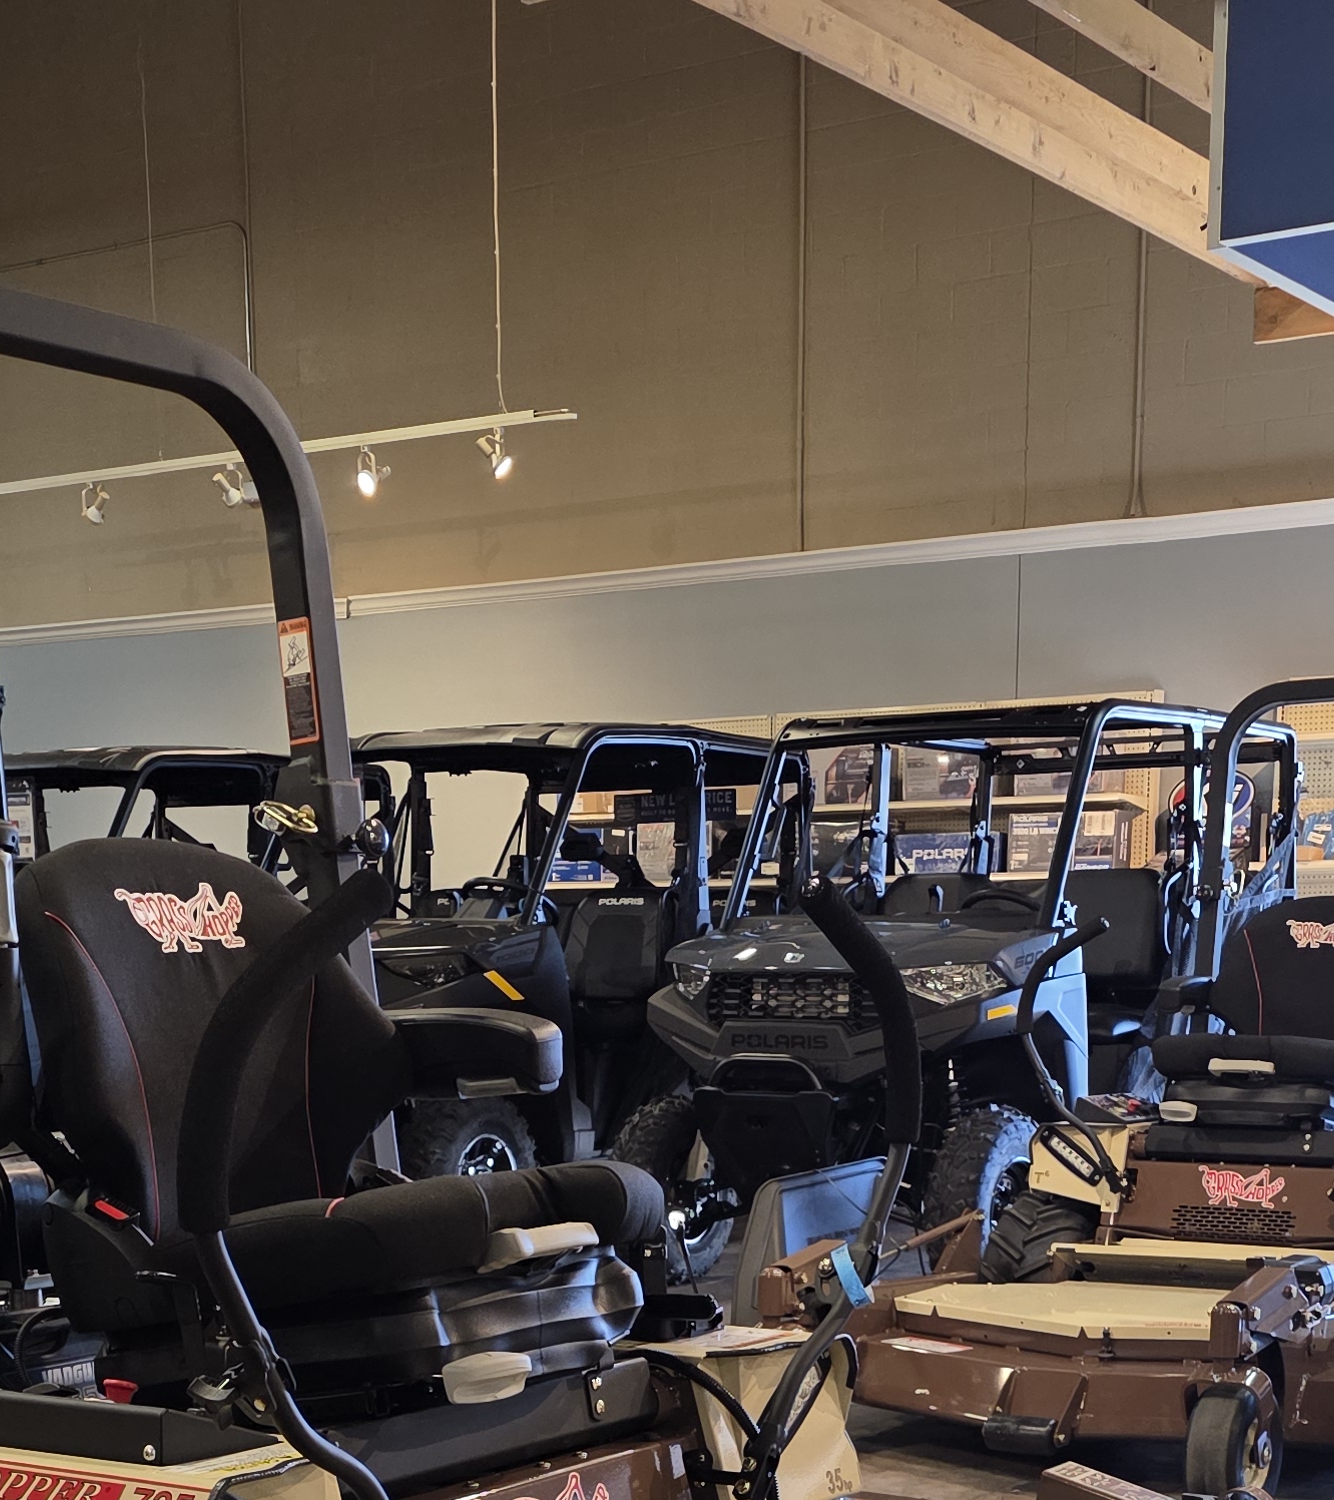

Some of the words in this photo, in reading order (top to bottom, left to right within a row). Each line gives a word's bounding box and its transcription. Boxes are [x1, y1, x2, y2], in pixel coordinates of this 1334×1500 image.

[598, 897, 645, 906] POLARIS
[730, 1033, 829, 1051] POLARIS
[1199, 1165, 1285, 1208] GRASSHOPPER
[41, 1361, 95, 1387] VANGU
